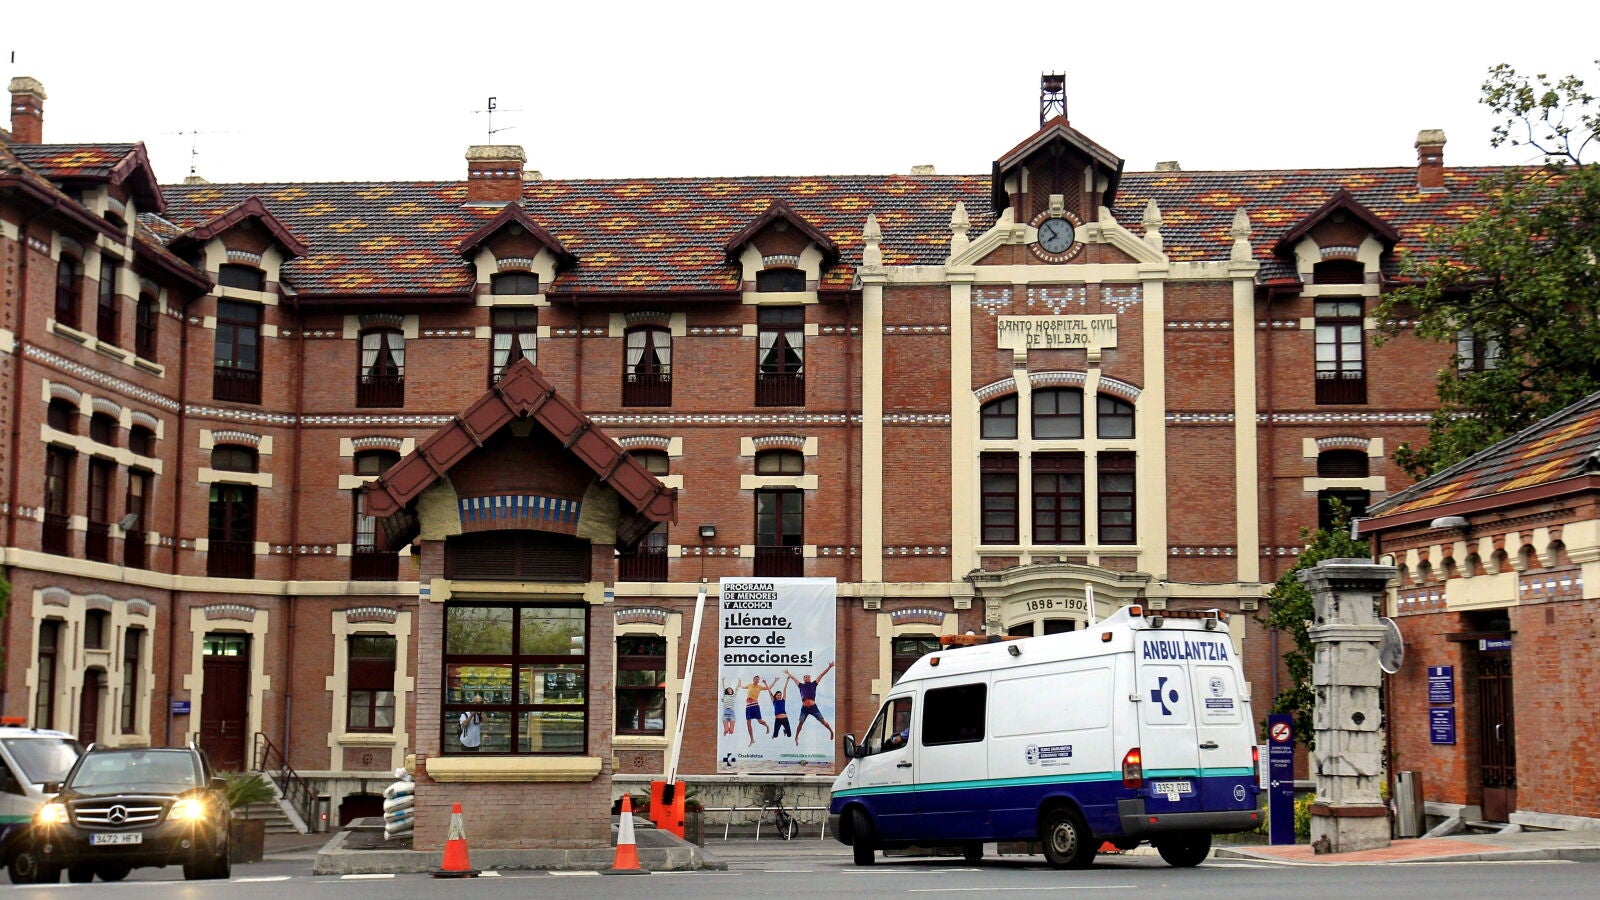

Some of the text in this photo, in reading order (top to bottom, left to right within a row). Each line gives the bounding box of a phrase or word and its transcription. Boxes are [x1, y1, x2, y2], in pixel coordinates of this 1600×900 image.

[998, 318, 1116, 331] SANTO HOSPITAL CIVIL
[1026, 333, 1040, 345] DE
[725, 592, 777, 600] DE MENORES
[733, 601, 772, 609] ALCOHOL
[725, 612, 792, 629] ¡Llénate,
[724, 630, 786, 648] pero de
[723, 649, 813, 663] emociones!
[1143, 640, 1229, 661] ANBULANTZIA
[96, 834, 118, 844] 3472
